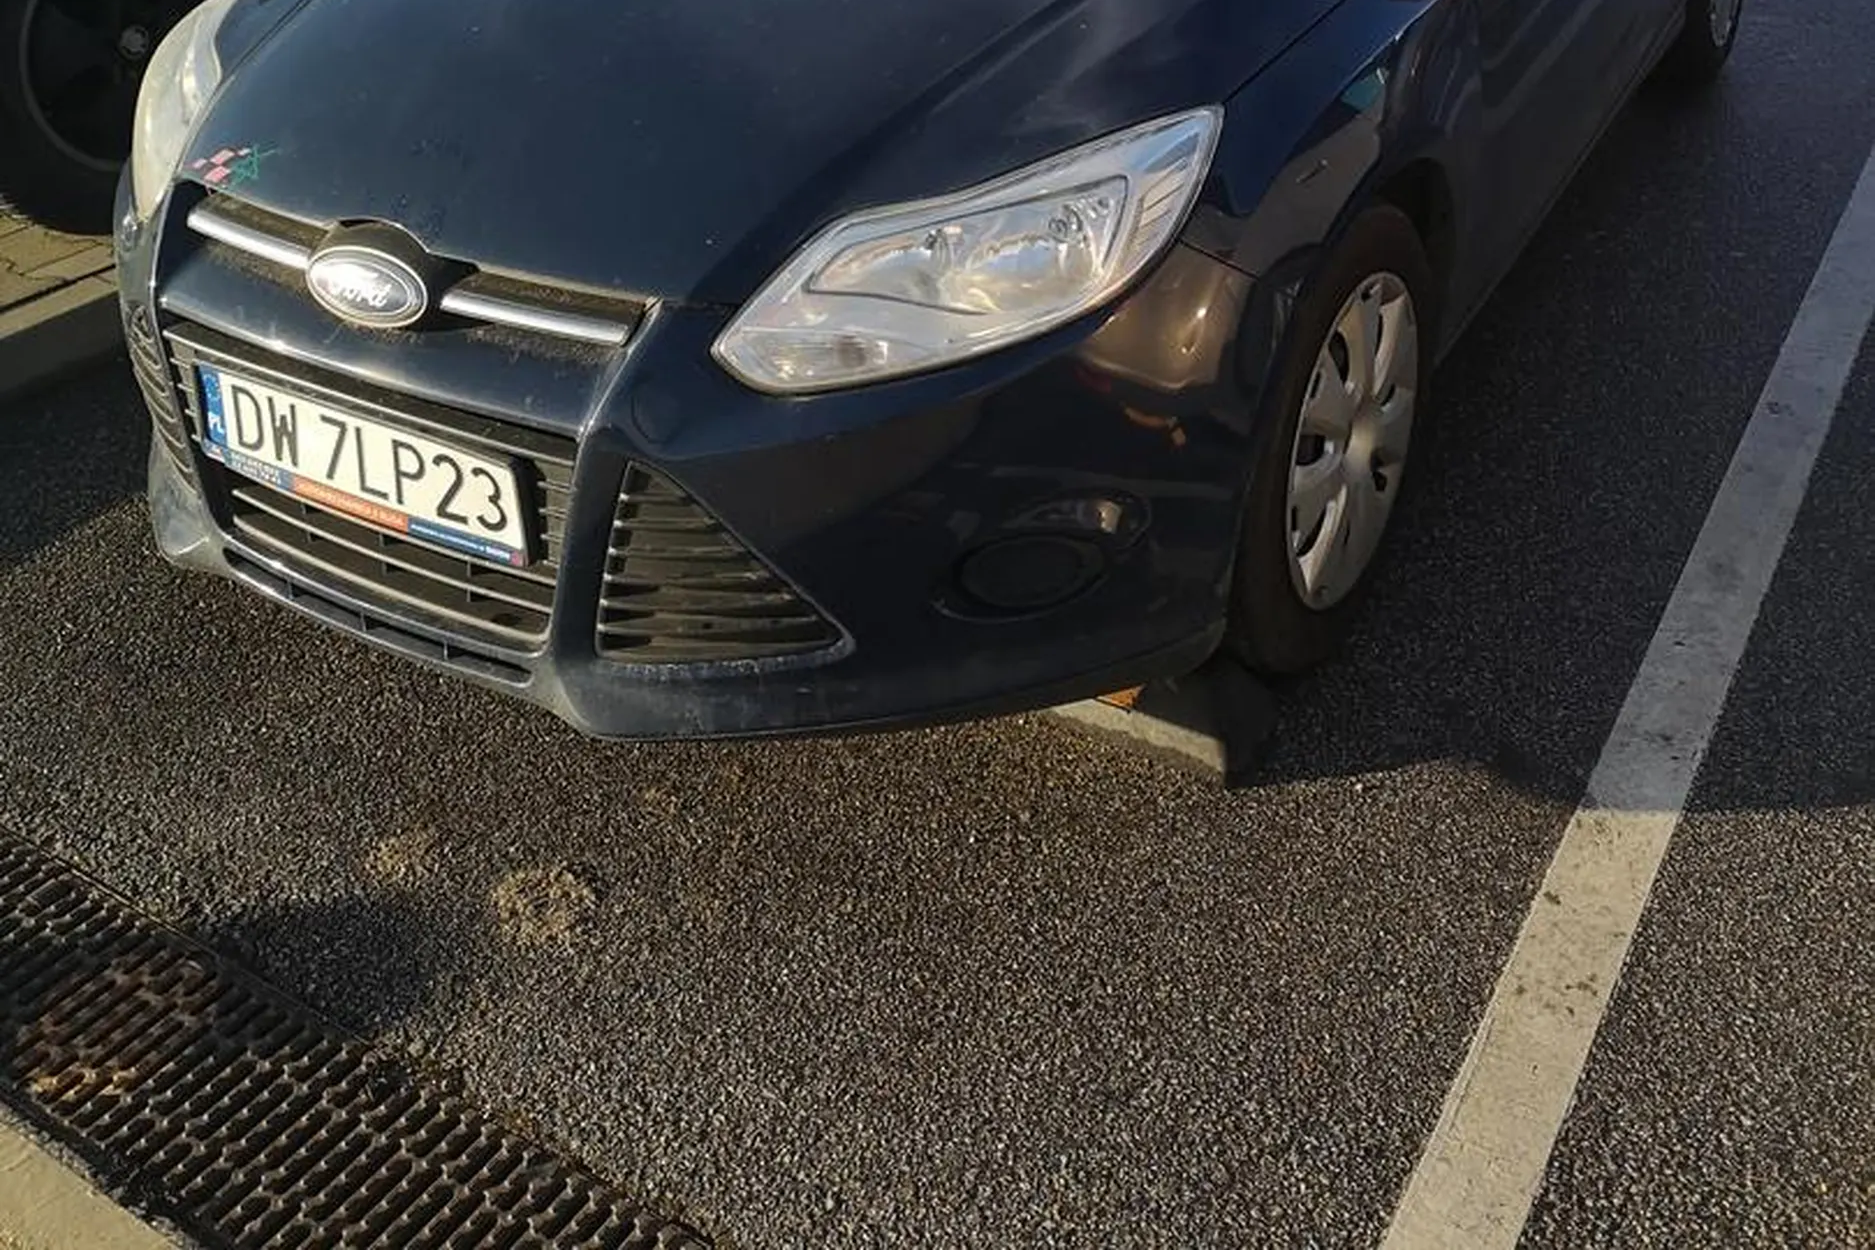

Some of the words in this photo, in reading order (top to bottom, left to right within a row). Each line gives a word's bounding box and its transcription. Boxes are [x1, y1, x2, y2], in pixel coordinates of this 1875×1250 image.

[208, 412, 225, 434] PL
[231, 384, 298, 467] DW
[319, 414, 507, 532] 7LP23
